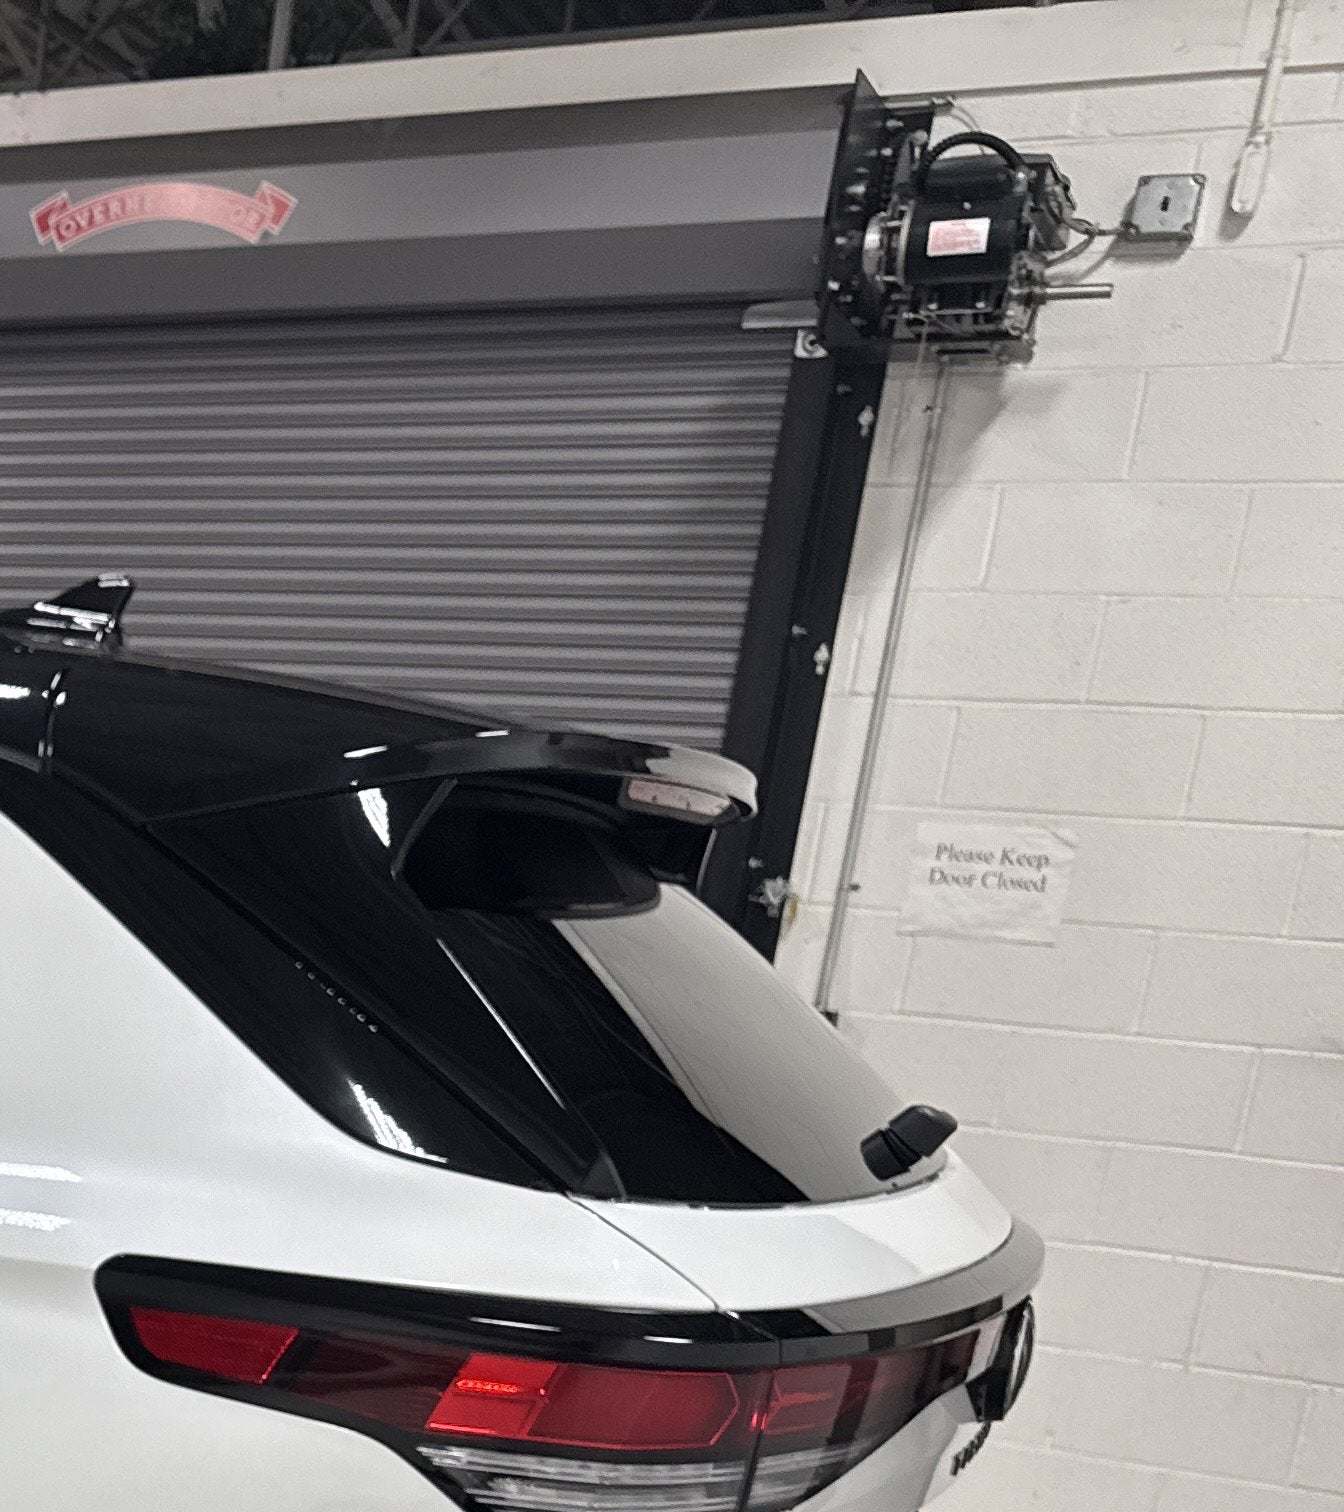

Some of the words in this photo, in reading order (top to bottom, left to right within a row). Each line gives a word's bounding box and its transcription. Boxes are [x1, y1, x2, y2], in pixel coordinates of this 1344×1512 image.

[935, 842, 995, 865] Please
[999, 847, 1050, 872] Keep
[928, 866, 978, 889] Door
[980, 870, 1047, 893] Closed
